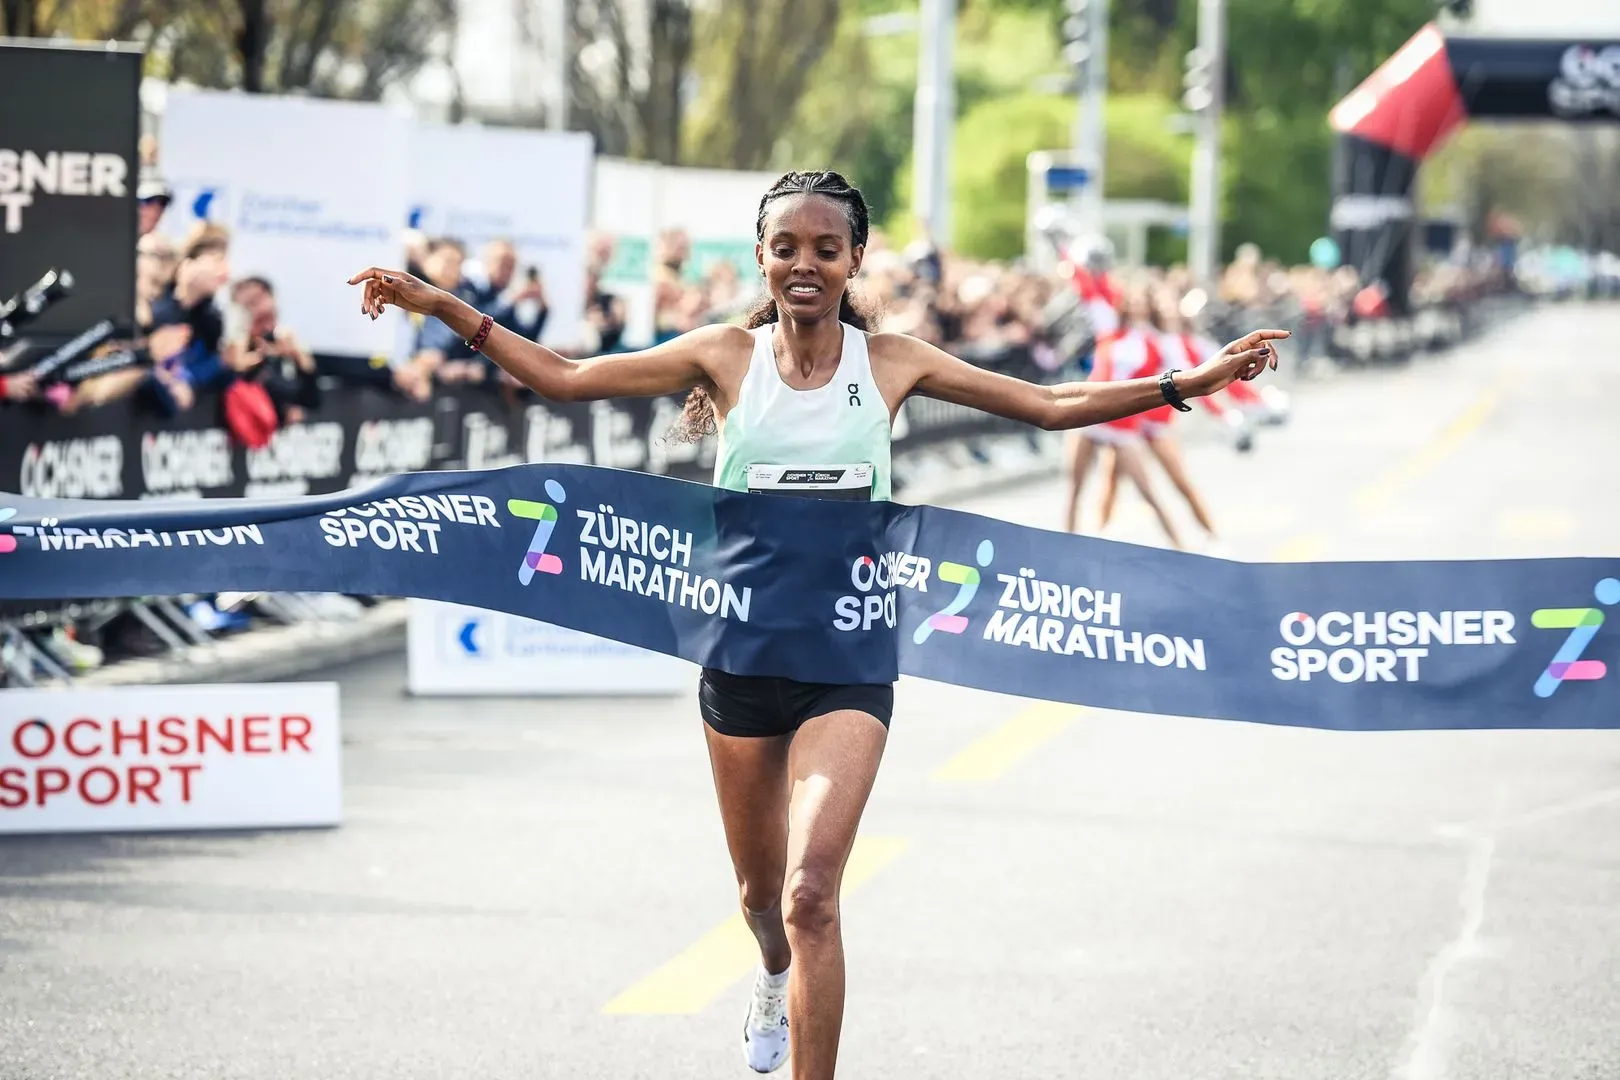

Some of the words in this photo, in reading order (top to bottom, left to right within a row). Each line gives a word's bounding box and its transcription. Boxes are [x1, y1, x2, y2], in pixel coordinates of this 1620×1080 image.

[319, 517, 441, 554] SPORT
[576, 503, 693, 567] ZÜRICH
[580, 546, 752, 623] MARATHON
[997, 567, 1121, 626] ZÜRICH
[983, 610, 1207, 671] MARATHON
[1280, 611, 1517, 646] OCHSNER
[1270, 647, 1429, 683] SPORT
[12, 715, 313, 759] OCHSNER
[0, 764, 203, 808] SPORT
